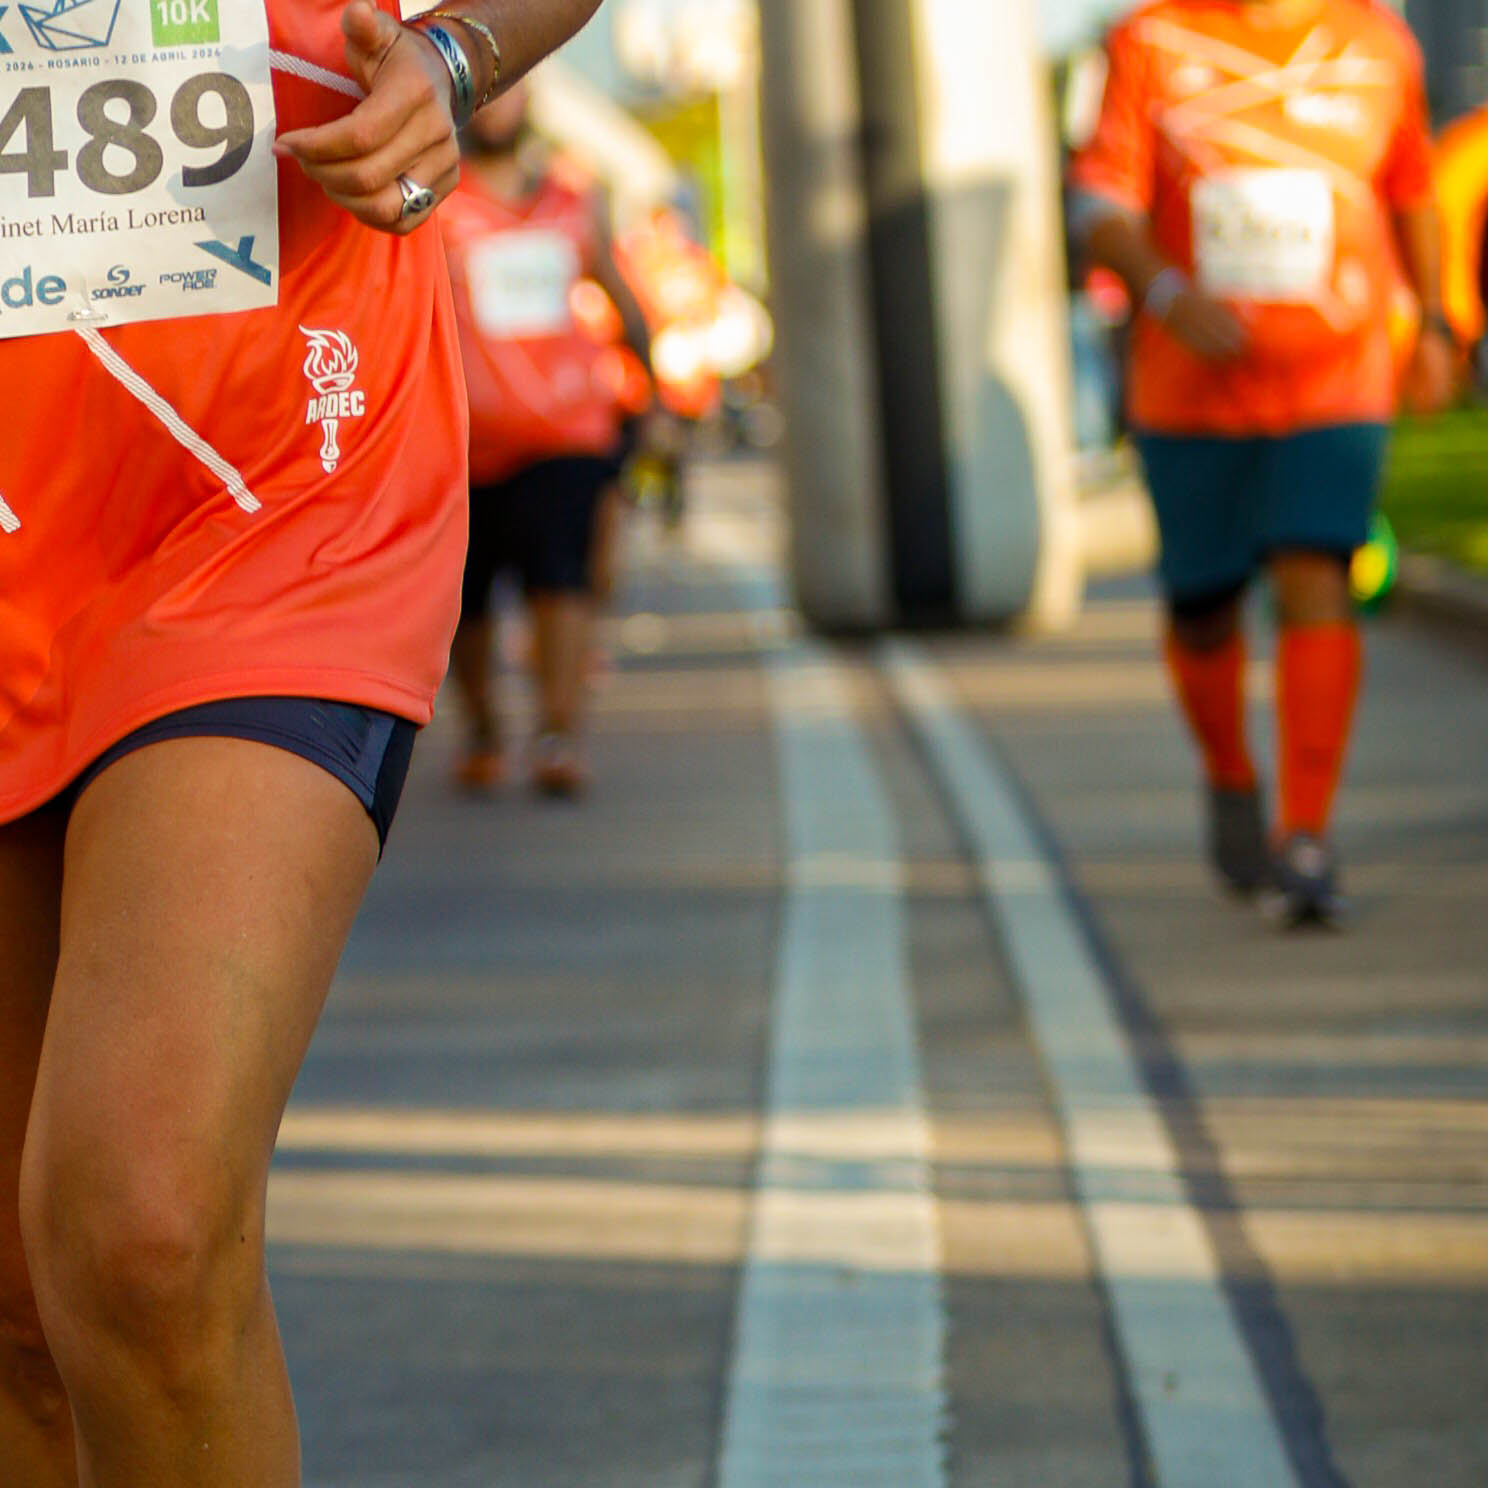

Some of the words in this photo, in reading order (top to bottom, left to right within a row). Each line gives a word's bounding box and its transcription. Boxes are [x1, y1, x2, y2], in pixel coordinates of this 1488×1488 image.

[48, 56, 100, 69] ROSARIO
[114, 54, 127, 65] 12
[132, 53, 147, 64] DE
[151, 50, 188, 62] ABRIL
[51, 210, 120, 236] María
[127, 205, 206, 230] Lorena
[306, 390, 366, 425] ARDEC
